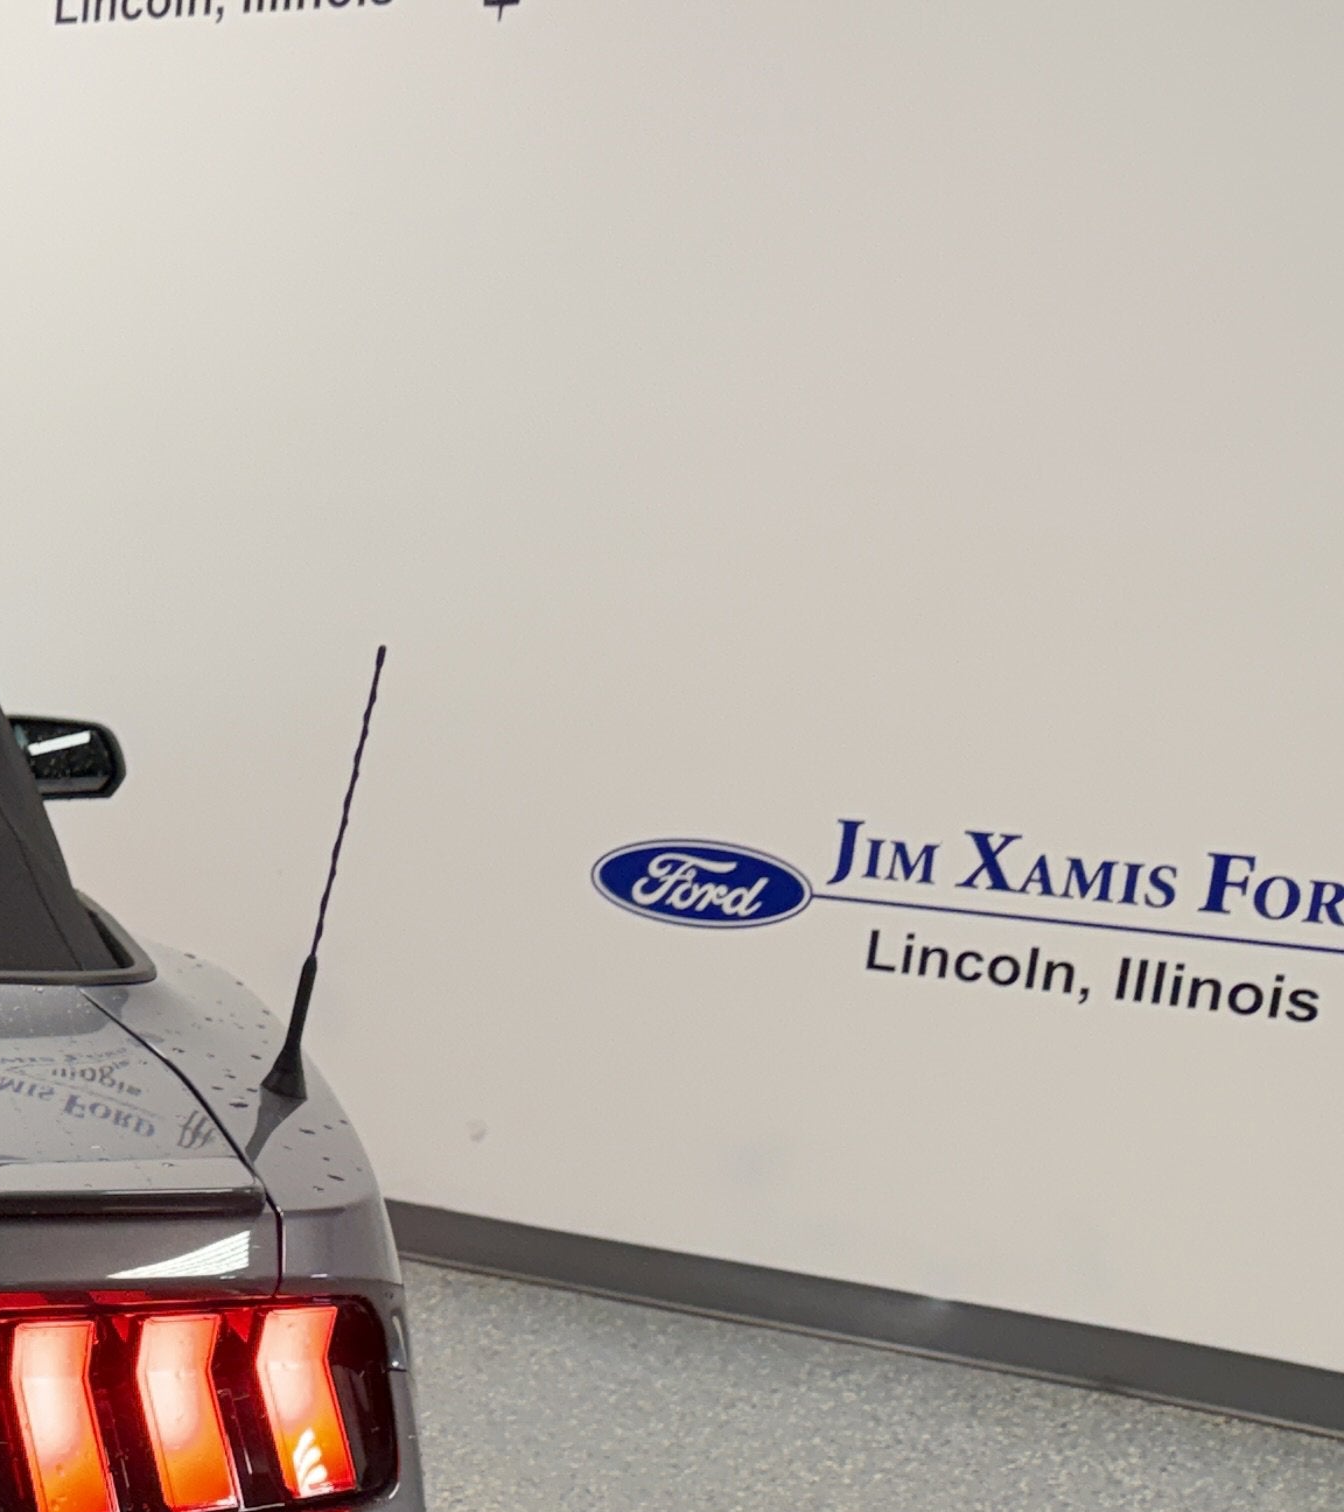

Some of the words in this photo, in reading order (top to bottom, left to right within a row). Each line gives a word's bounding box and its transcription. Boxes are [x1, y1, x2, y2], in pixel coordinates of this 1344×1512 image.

[630, 851, 772, 918] Ford
[826, 819, 941, 886] JIM
[957, 830, 1178, 909] XAMIS
[865, 929, 1091, 1004] Lincoln,
[1115, 957, 1321, 1023] Illinois
